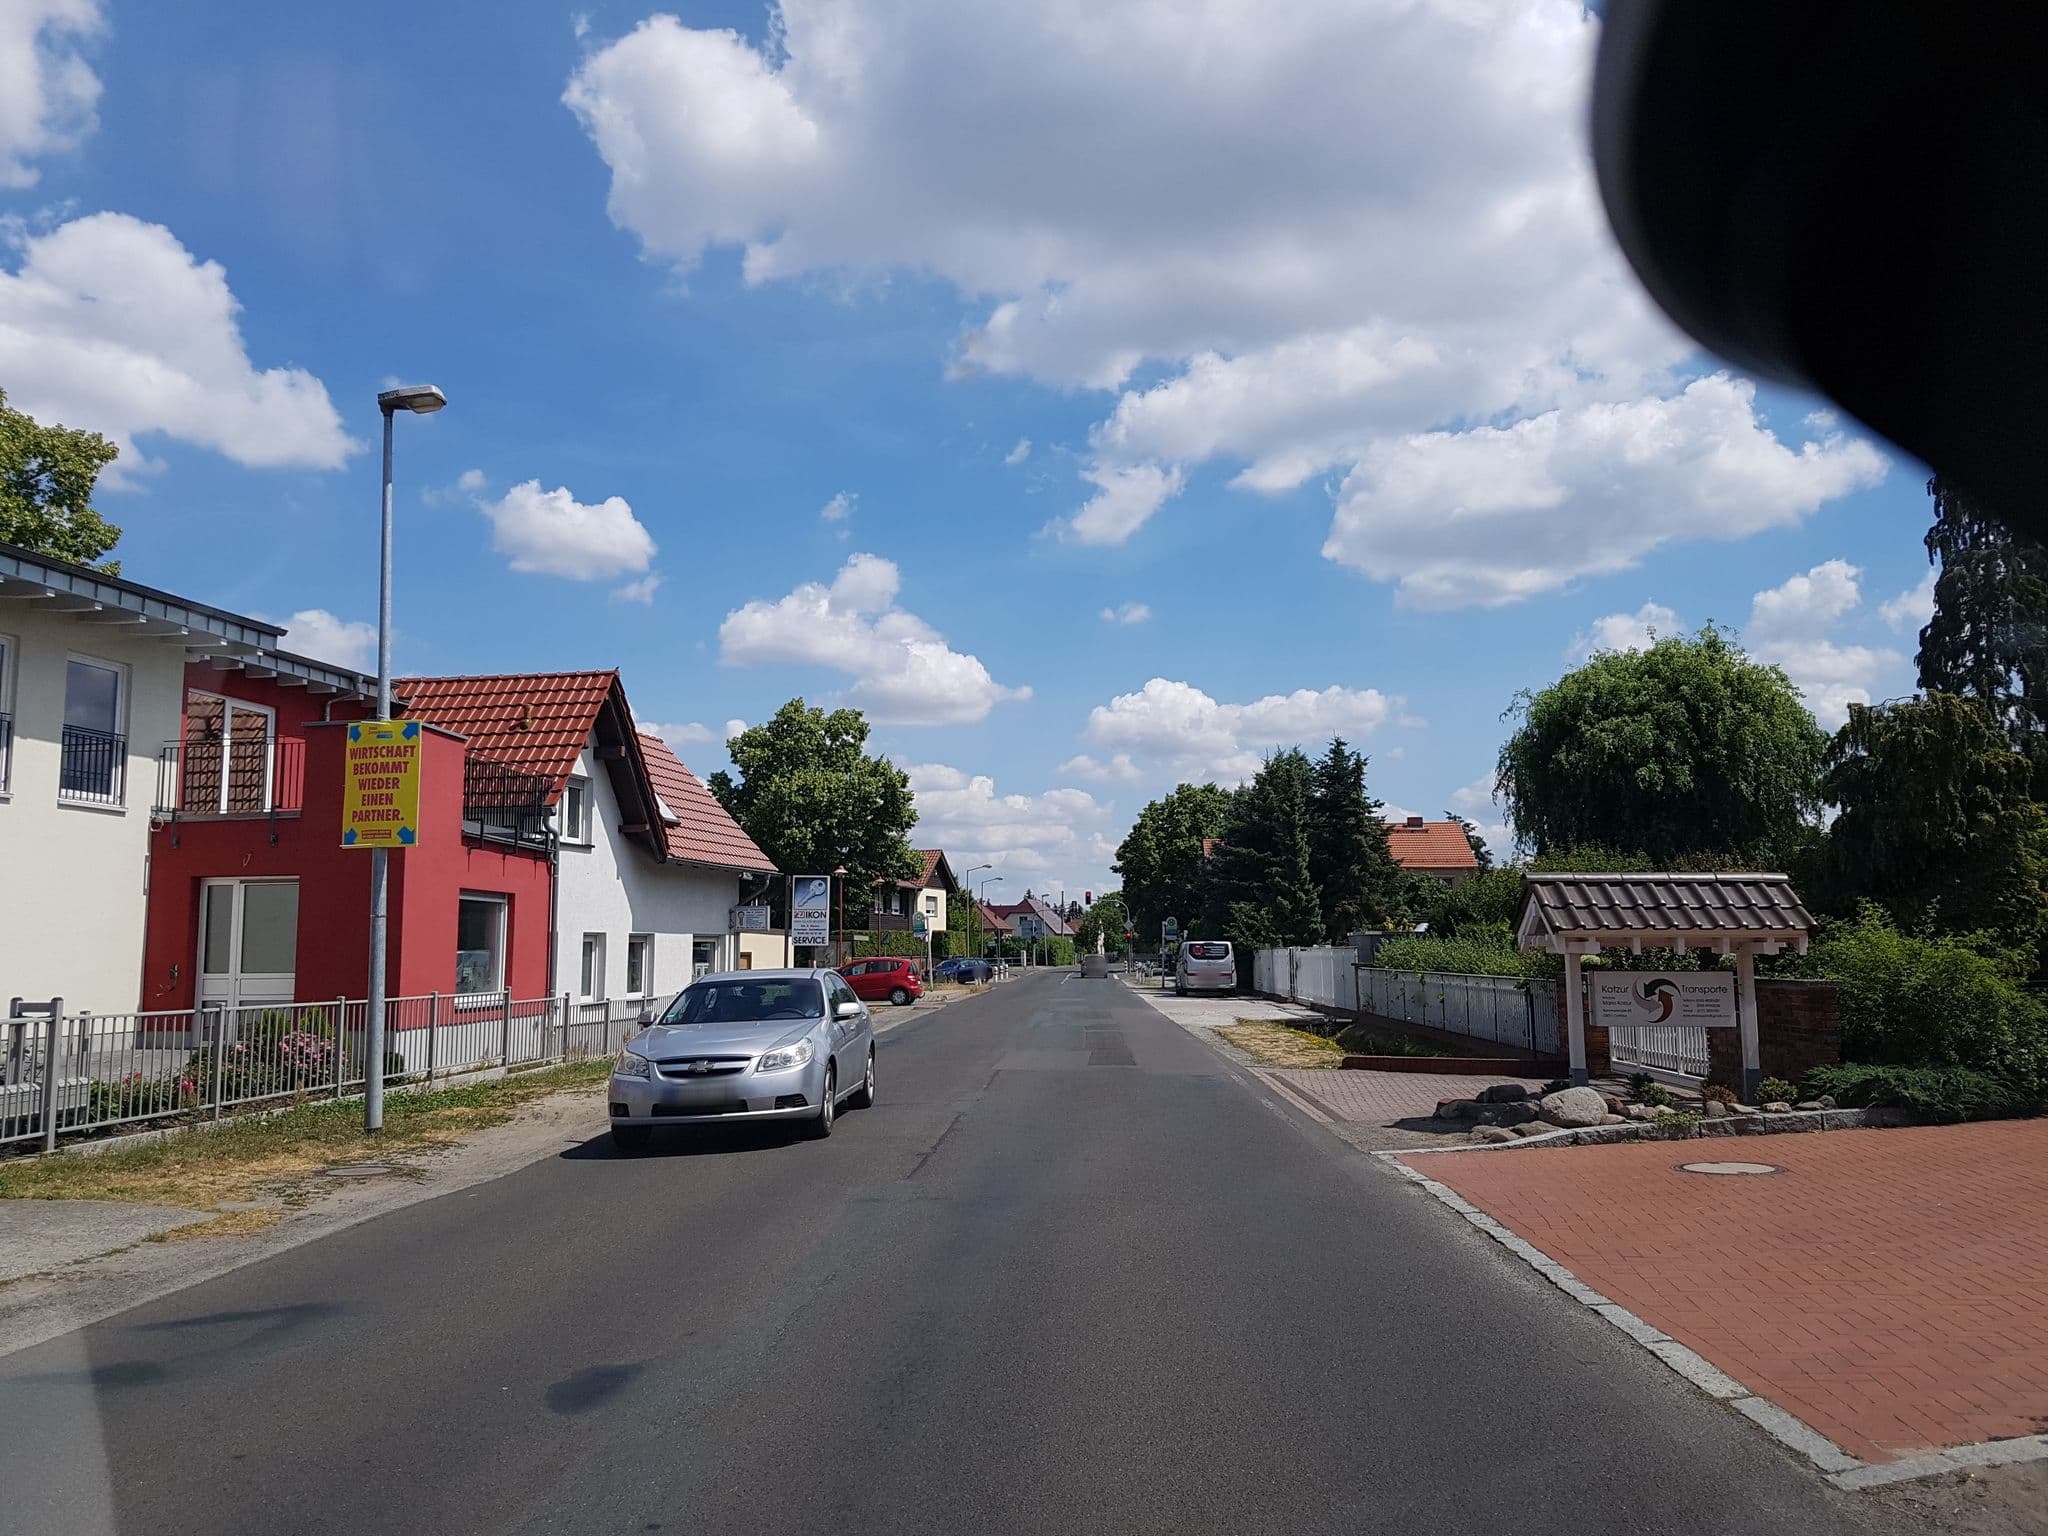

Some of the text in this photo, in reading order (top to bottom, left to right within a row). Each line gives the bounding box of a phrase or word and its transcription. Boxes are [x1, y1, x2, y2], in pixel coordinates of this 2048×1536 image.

[349, 745, 416, 760] WIRTSCHAFT
[353, 761, 410, 775] BEKOMMT
[358, 777, 400, 791] WIEDER
[361, 793, 394, 806] EINEN
[352, 809, 405, 822] PARTNER.
[805, 911, 827, 919] IKON
[793, 936, 826, 944] SERVICE
[1601, 985, 1728, 994] Katzur Transporte
